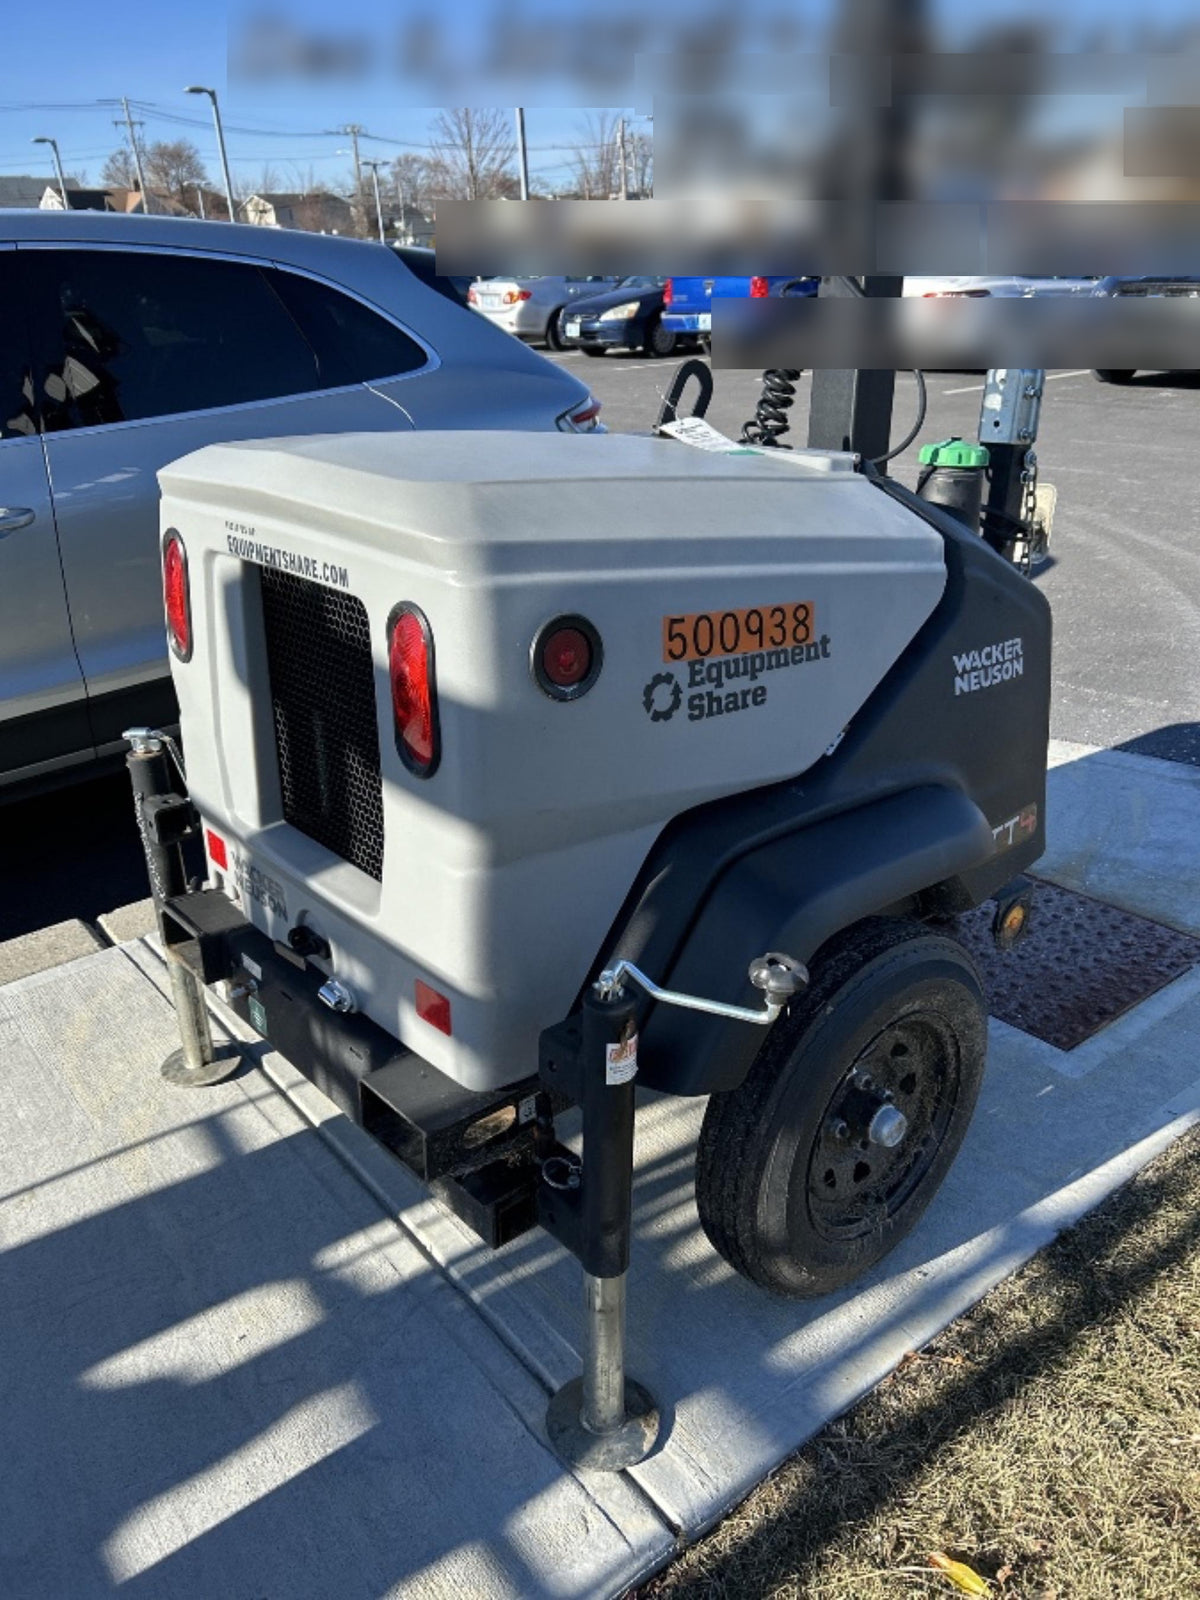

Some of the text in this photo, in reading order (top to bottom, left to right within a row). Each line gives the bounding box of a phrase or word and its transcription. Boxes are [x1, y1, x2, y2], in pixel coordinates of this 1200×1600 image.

[226, 534, 349, 588] EQUIPMENTSHARE.COM
[667, 603, 810, 660] 500938
[687, 634, 831, 688] Equipment
[952, 638, 1023, 674] WACKER
[954, 657, 1024, 696] NEUSON
[687, 685, 767, 721] Share
